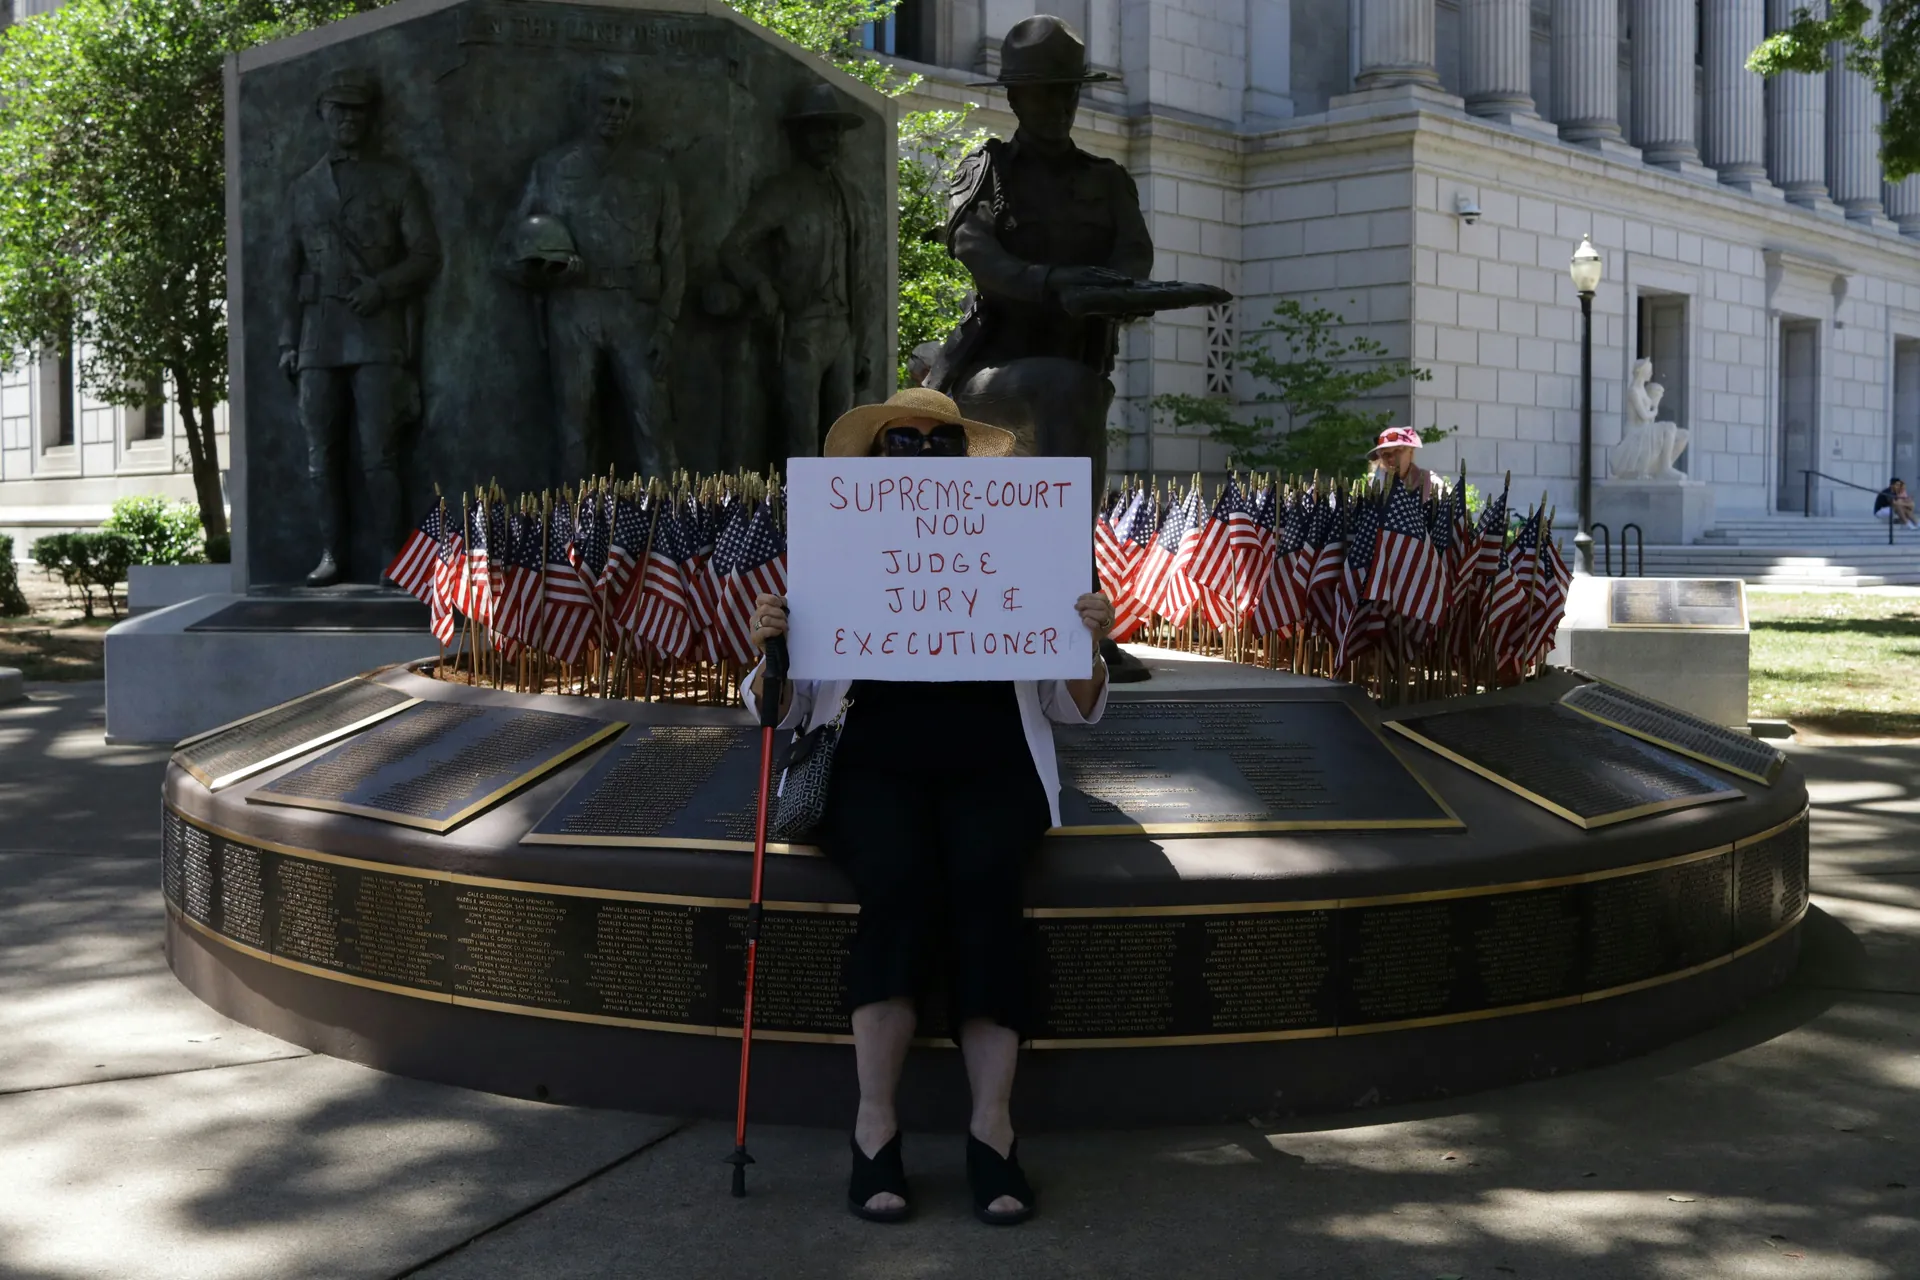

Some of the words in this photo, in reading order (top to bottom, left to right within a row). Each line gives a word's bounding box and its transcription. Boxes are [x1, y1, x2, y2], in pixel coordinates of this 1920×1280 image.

[829, 476, 1072, 512] SUPREME-COURT
[916, 513, 985, 538] NOW
[882, 550, 997, 575] JUDGE
[885, 587, 978, 617] JURY
[834, 627, 1058, 656] EXECUTIONER
